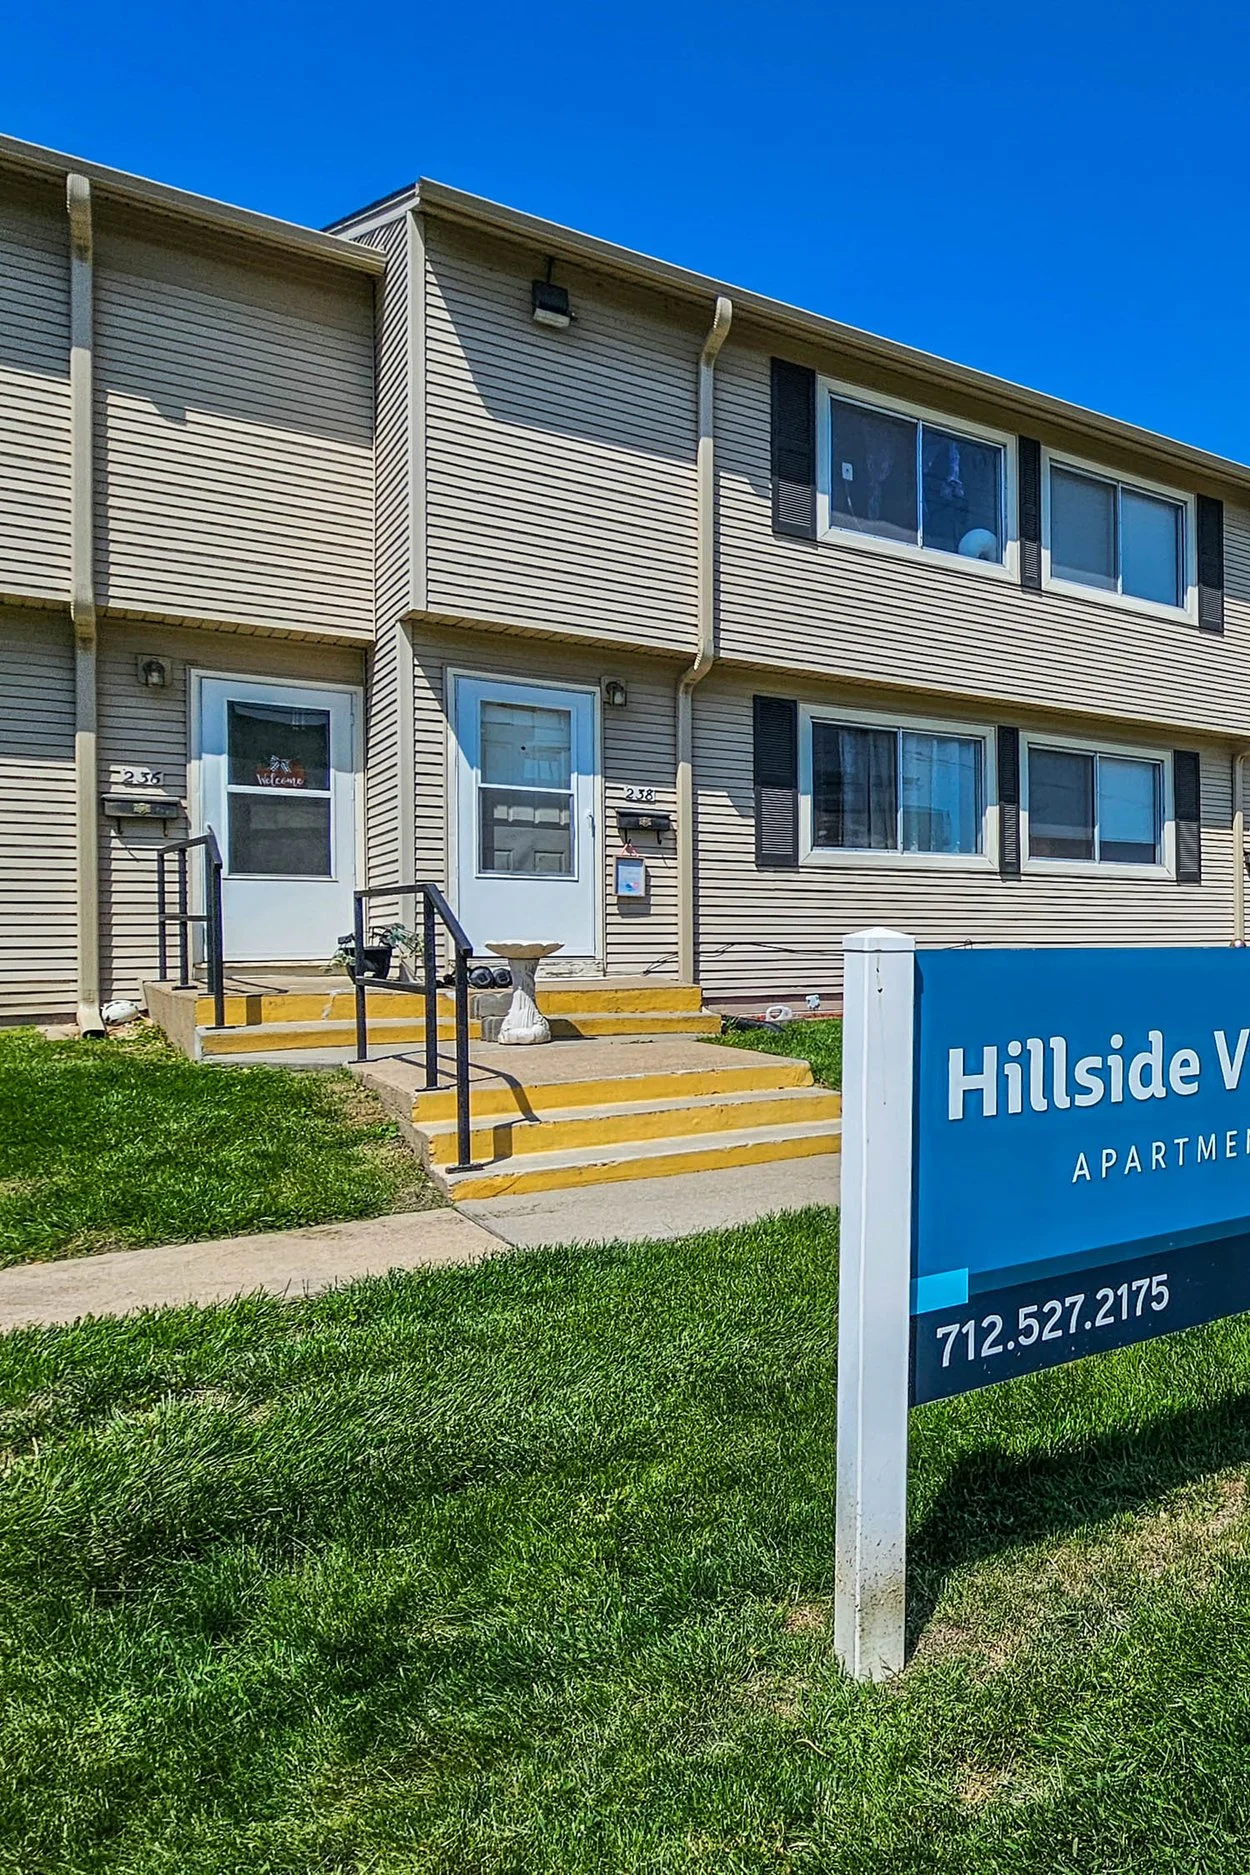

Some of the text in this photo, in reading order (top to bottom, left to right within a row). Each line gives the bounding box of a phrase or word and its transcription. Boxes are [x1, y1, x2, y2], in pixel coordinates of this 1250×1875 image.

[256, 773, 305, 787] Welcome
[625, 788, 656, 801] 238
[947, 1029, 1201, 1121] Hillside
[936, 1273, 1170, 1368] 712.527.2175
